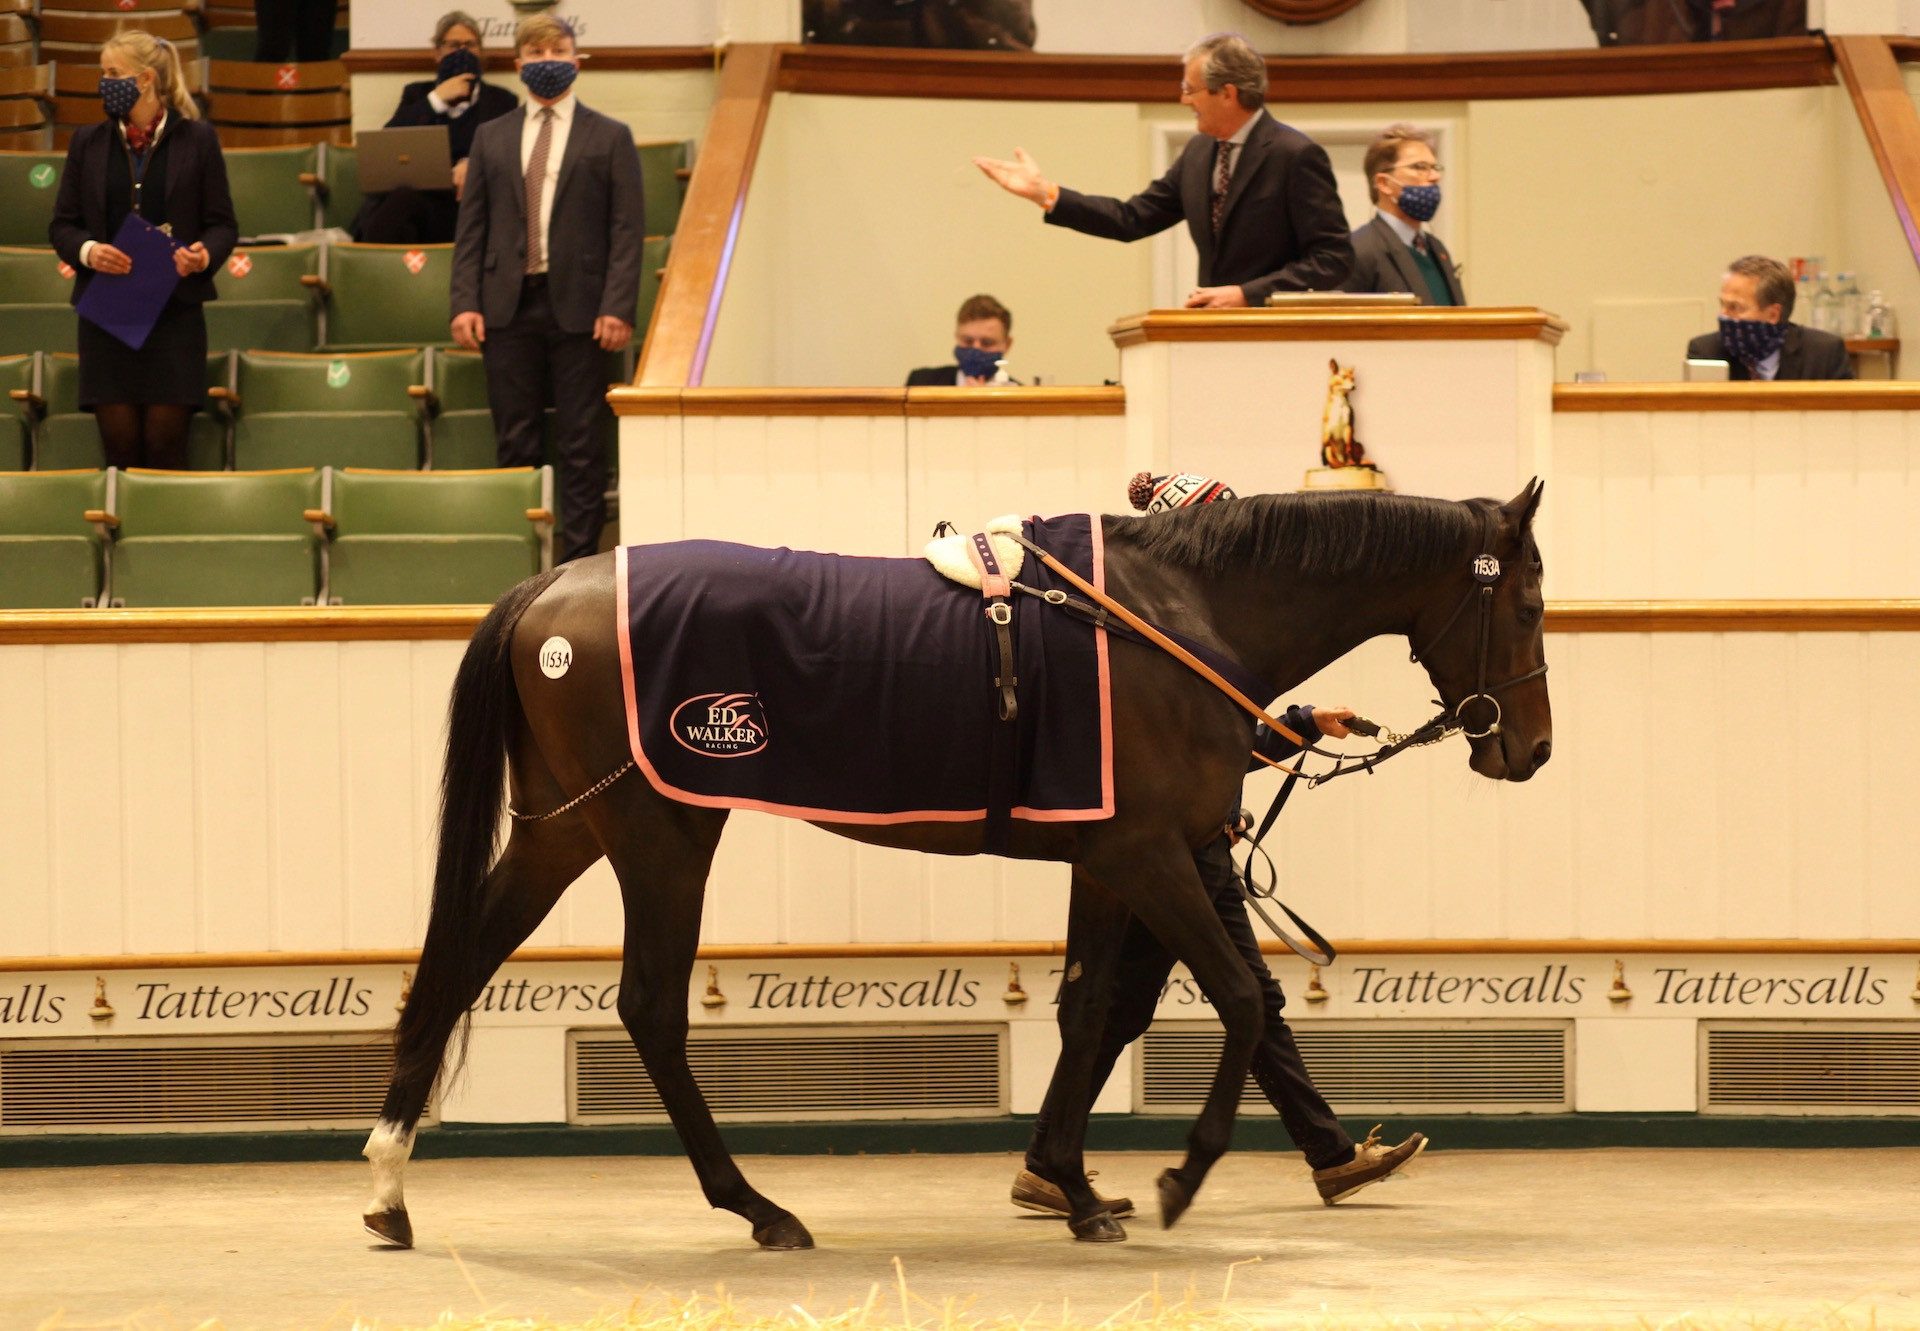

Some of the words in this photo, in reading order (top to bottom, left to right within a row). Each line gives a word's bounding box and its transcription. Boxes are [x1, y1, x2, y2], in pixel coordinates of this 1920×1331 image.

[1473, 558, 1500, 577] 1153A
[542, 651, 570, 668] 1153A
[707, 707, 738, 726] ED
[686, 726, 757, 744] WALKER
[705, 742, 739, 750] RACING
[135, 976, 373, 1020] Tattersalls
[469, 978, 622, 1012] attersa
[748, 968, 981, 1009] Tattersalls
[1353, 965, 1586, 1005] Tattersalls
[1654, 966, 1889, 1006] Tattersalls
